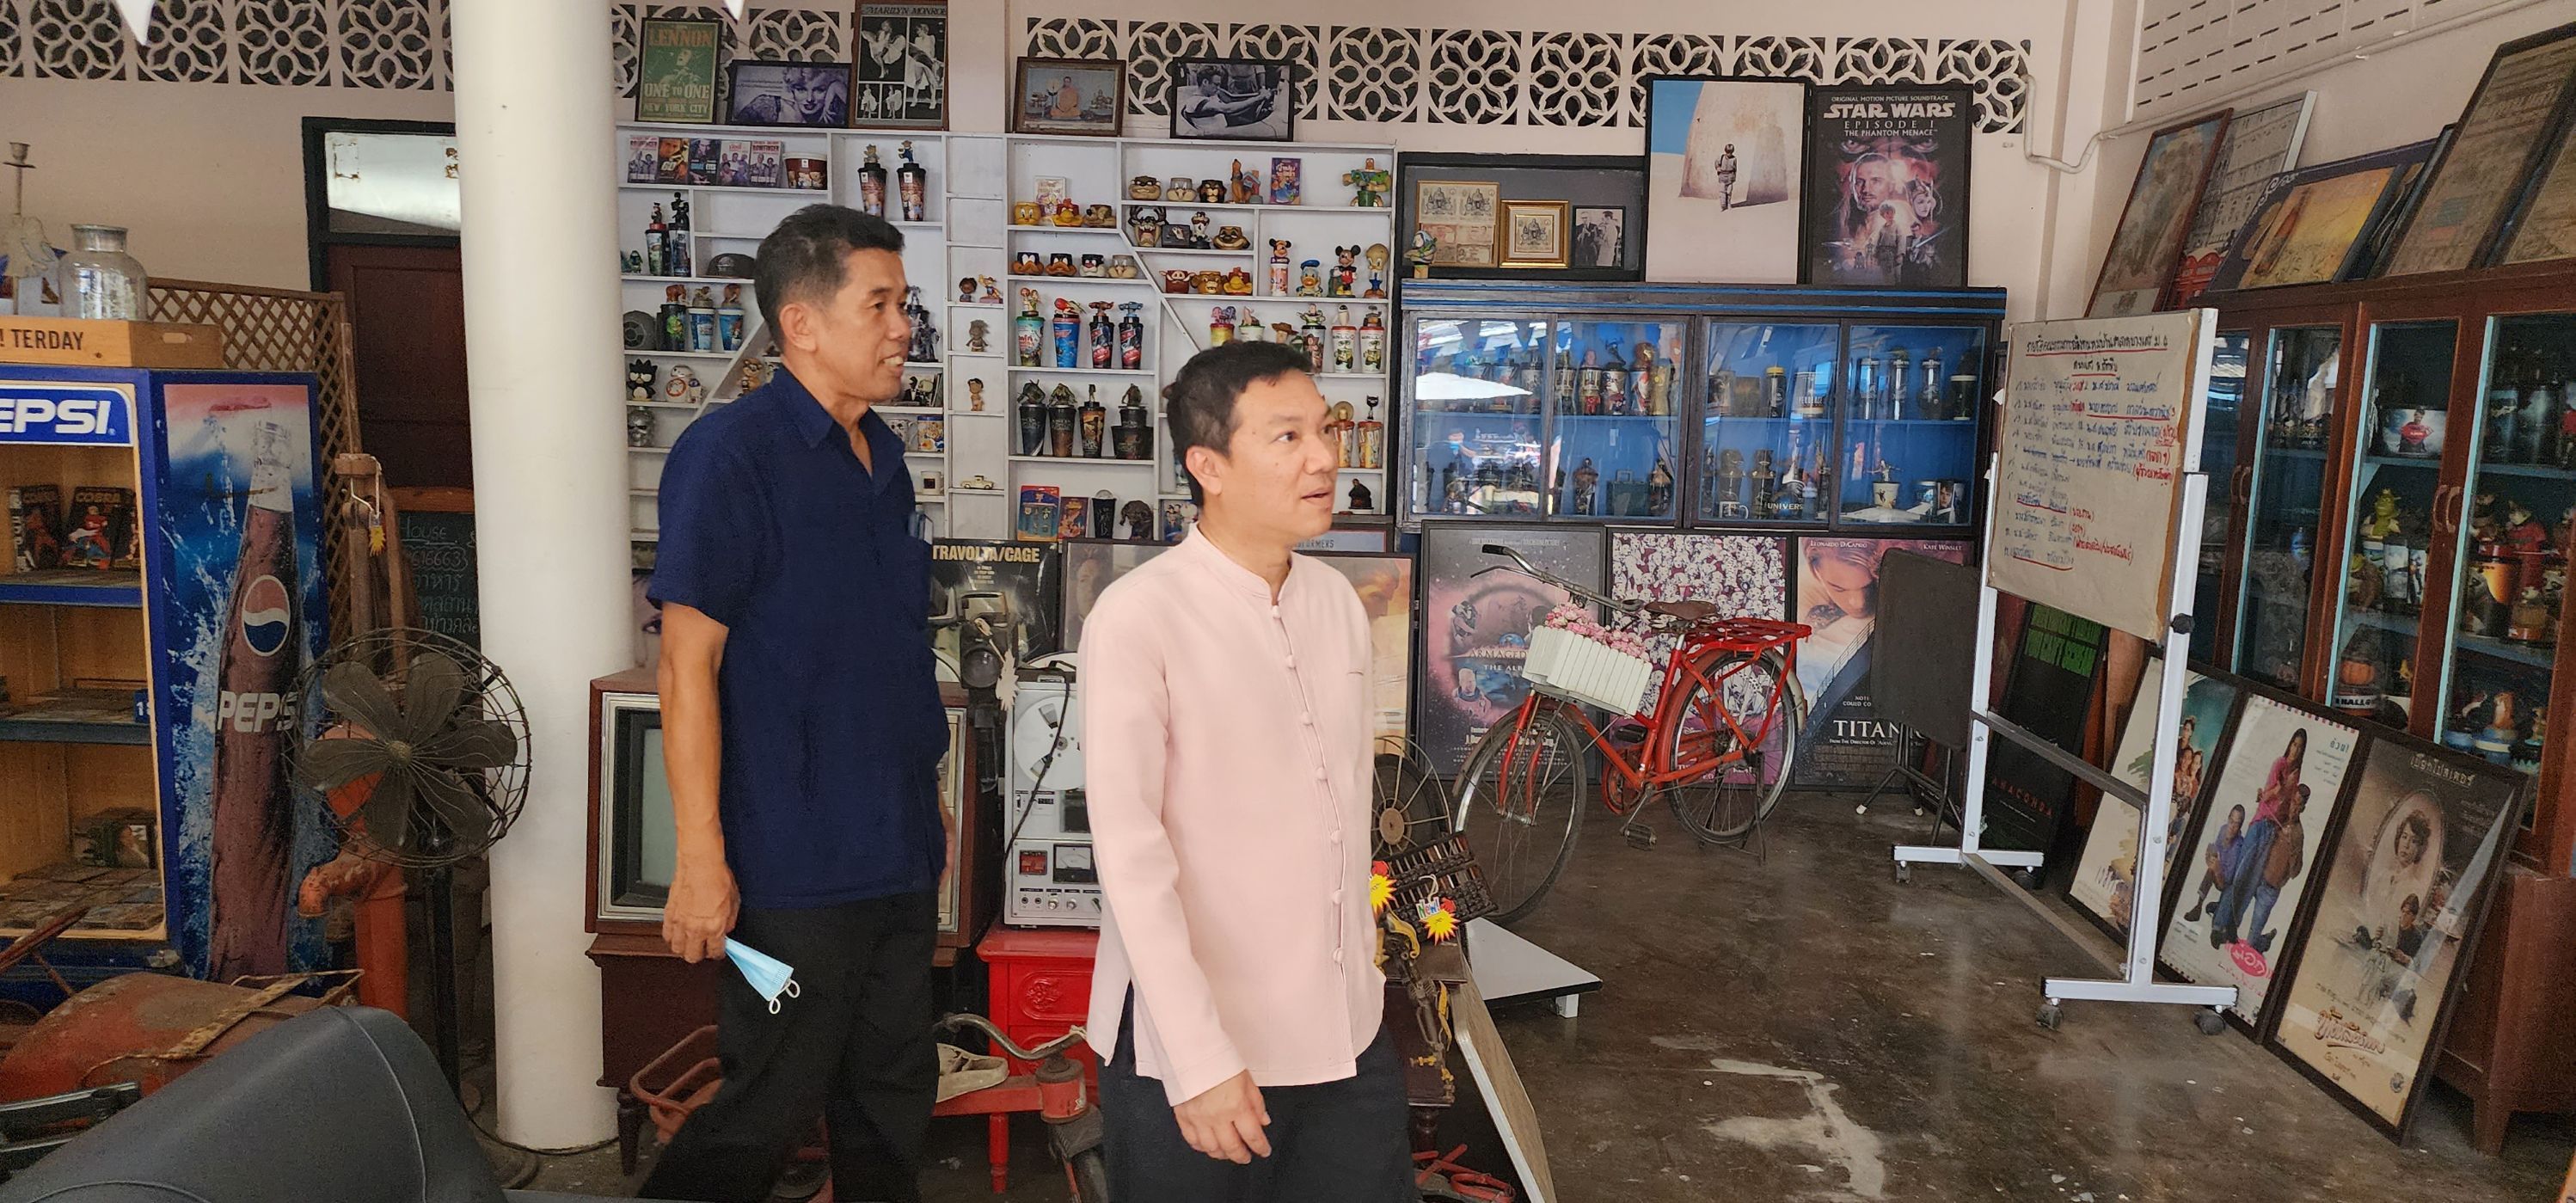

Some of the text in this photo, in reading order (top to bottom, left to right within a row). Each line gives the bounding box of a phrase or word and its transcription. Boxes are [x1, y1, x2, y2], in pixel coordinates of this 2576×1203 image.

[647, 28, 713, 47] LENNON
[684, 83, 710, 99] ONE
[690, 104, 709, 114] CITY
[1823, 102, 1956, 119] STAR WARS
[1844, 120, 1917, 129] EPISODE
